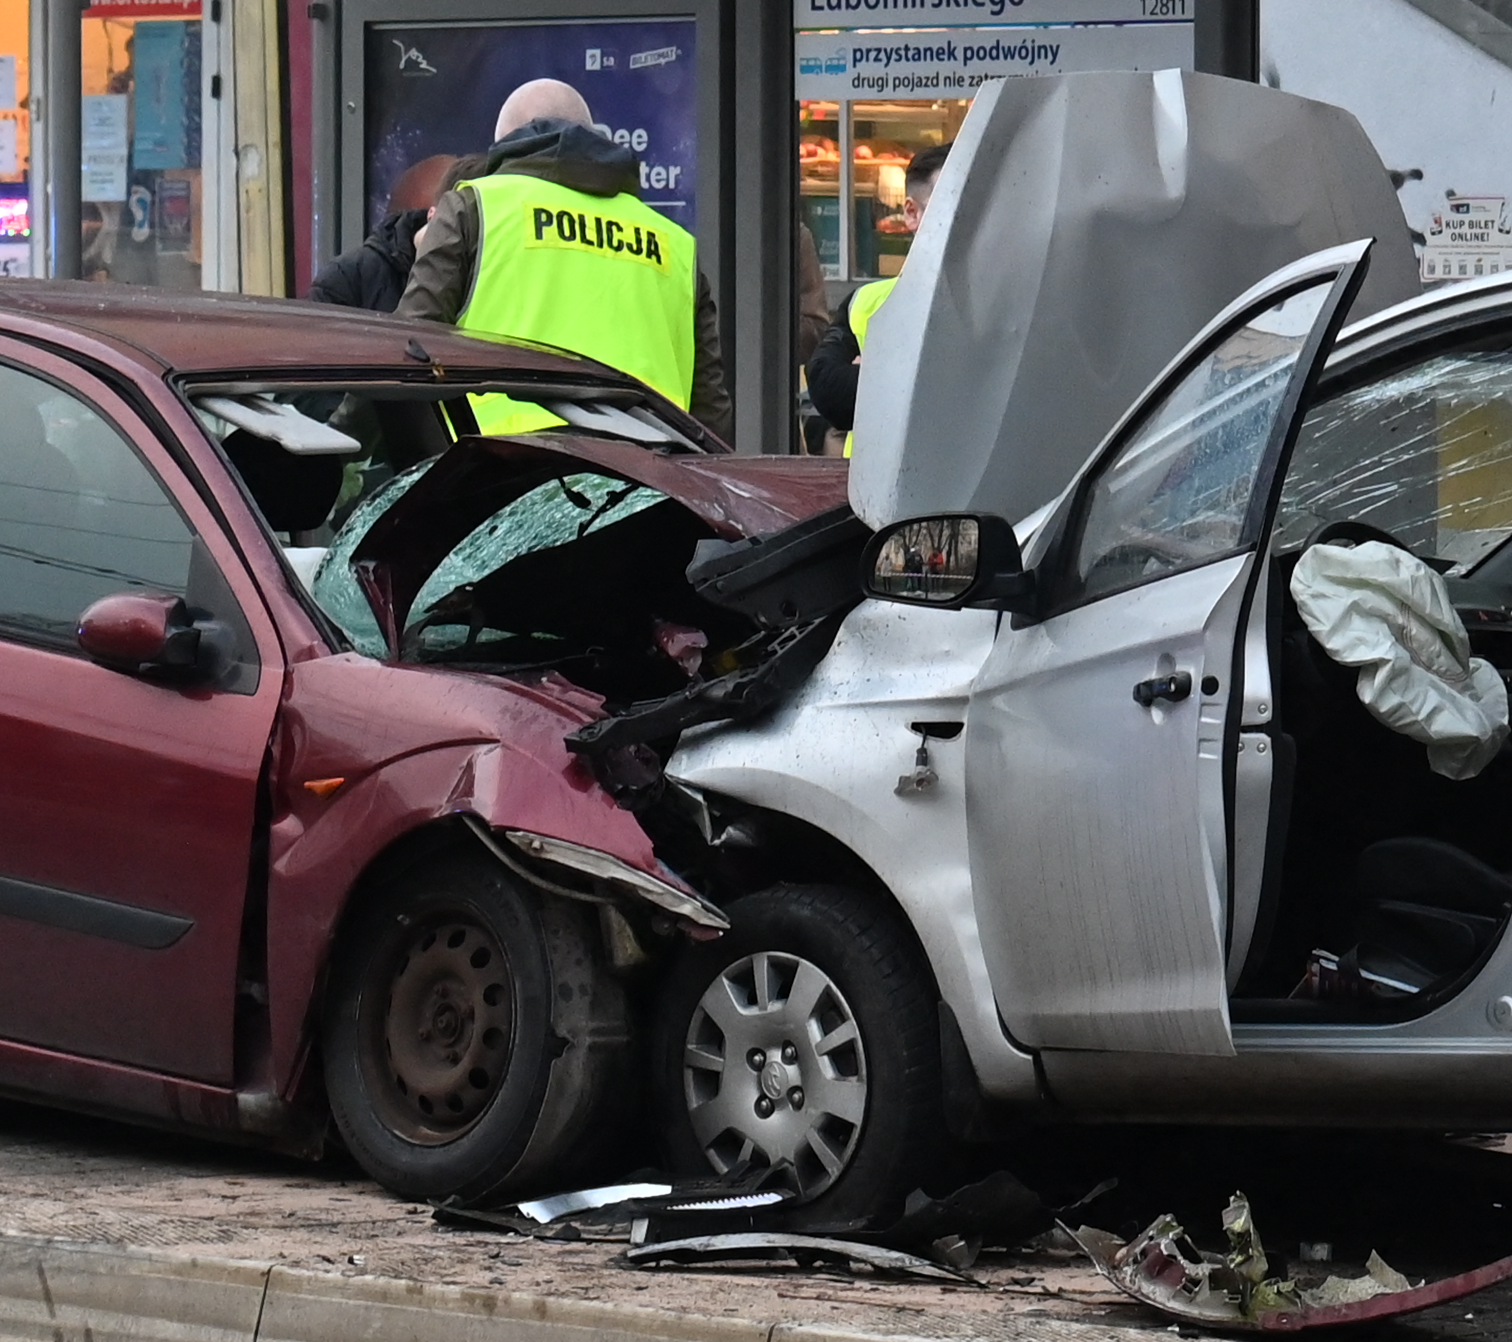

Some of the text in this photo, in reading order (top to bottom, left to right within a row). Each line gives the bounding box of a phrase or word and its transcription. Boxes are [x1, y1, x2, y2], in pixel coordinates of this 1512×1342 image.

[851, 38, 1061, 68] przystanek podwójny
[851, 72, 890, 93] drugi
[892, 71, 940, 91] pojazd
[943, 70, 965, 89] nie
[533, 207, 662, 266] POLICJA
[1445, 220, 1496, 230] KUP BILET
[1450, 232, 1490, 243] ONLINE!
